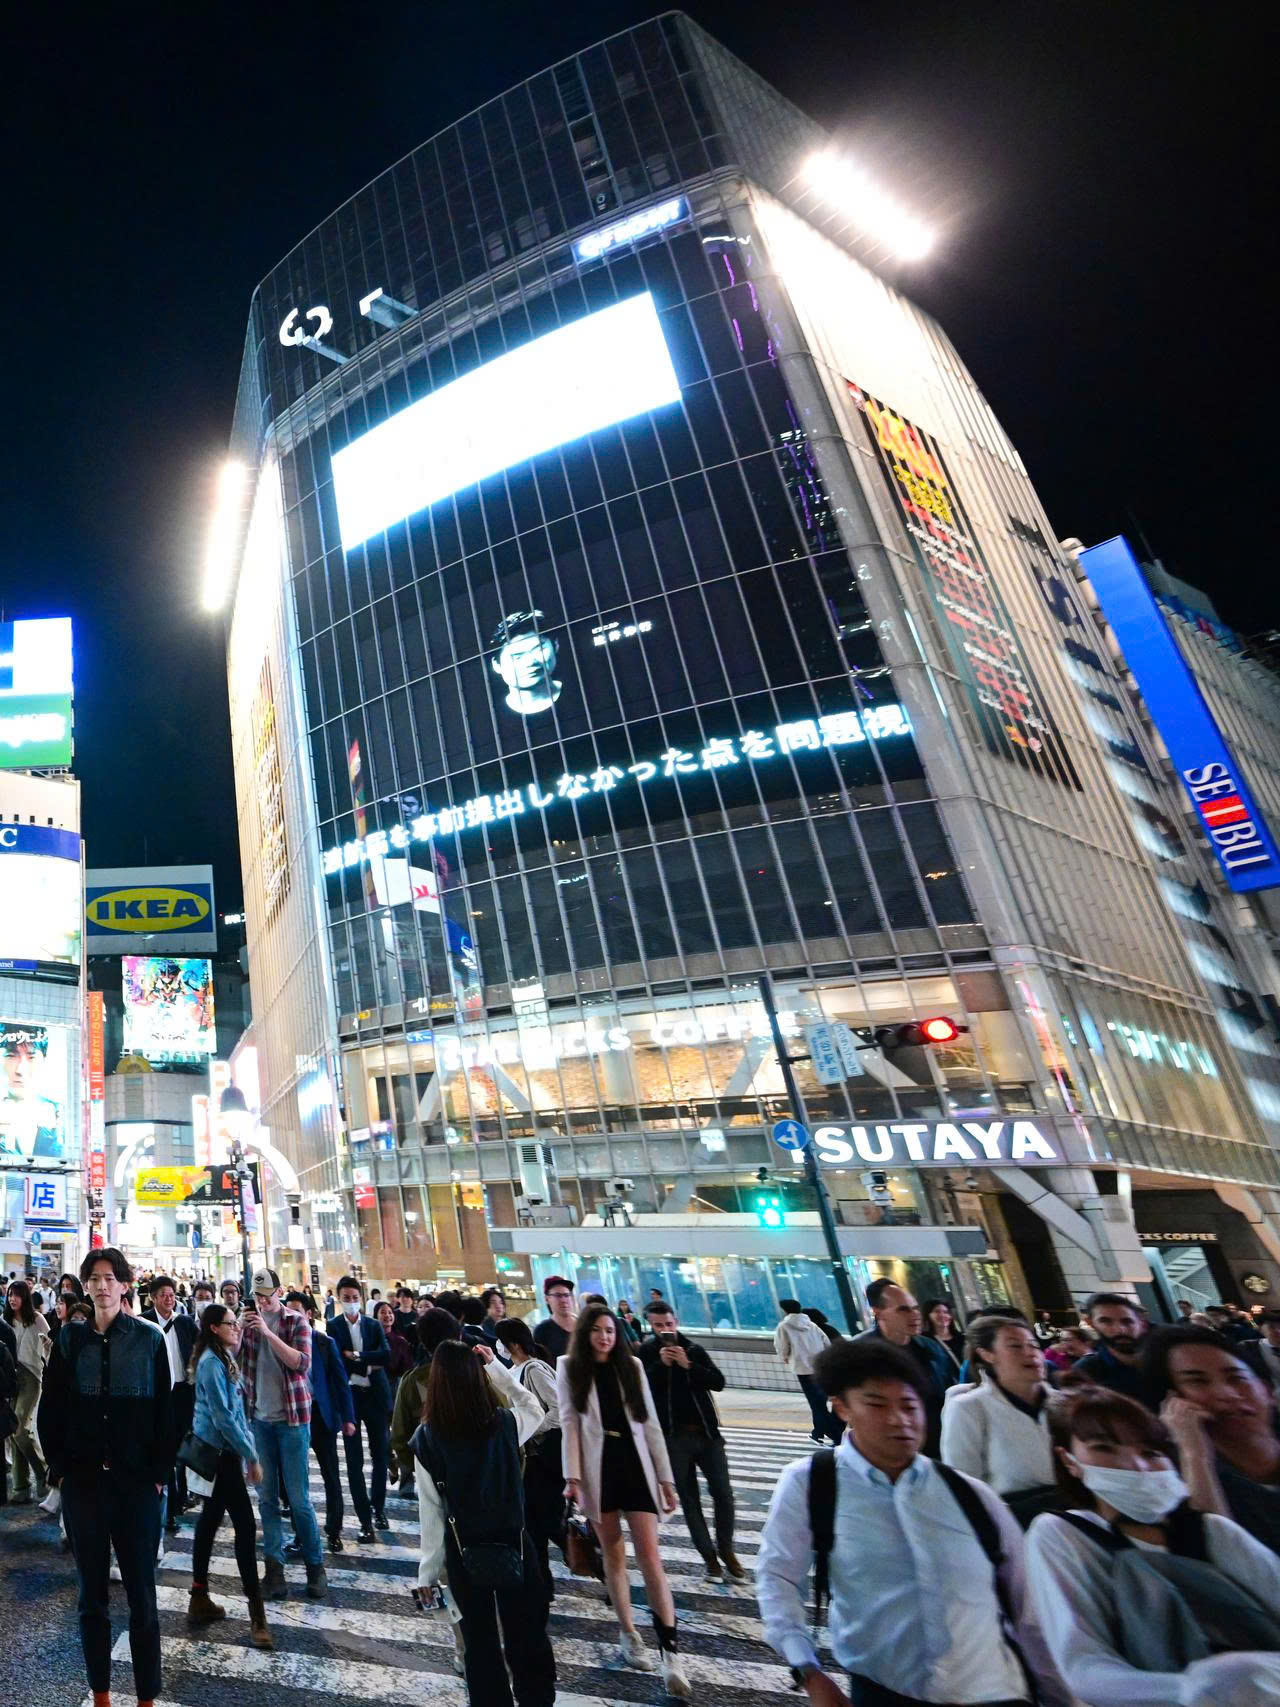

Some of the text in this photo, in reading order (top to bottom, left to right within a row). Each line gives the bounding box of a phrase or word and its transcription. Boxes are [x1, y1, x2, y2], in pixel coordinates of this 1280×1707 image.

[1183, 762, 1271, 870] SEIBU
[96, 898, 202, 920] IKEA
[790, 1121, 1057, 1164] SUTAYA
[1163, 1233, 1218, 1241] COFFEE
